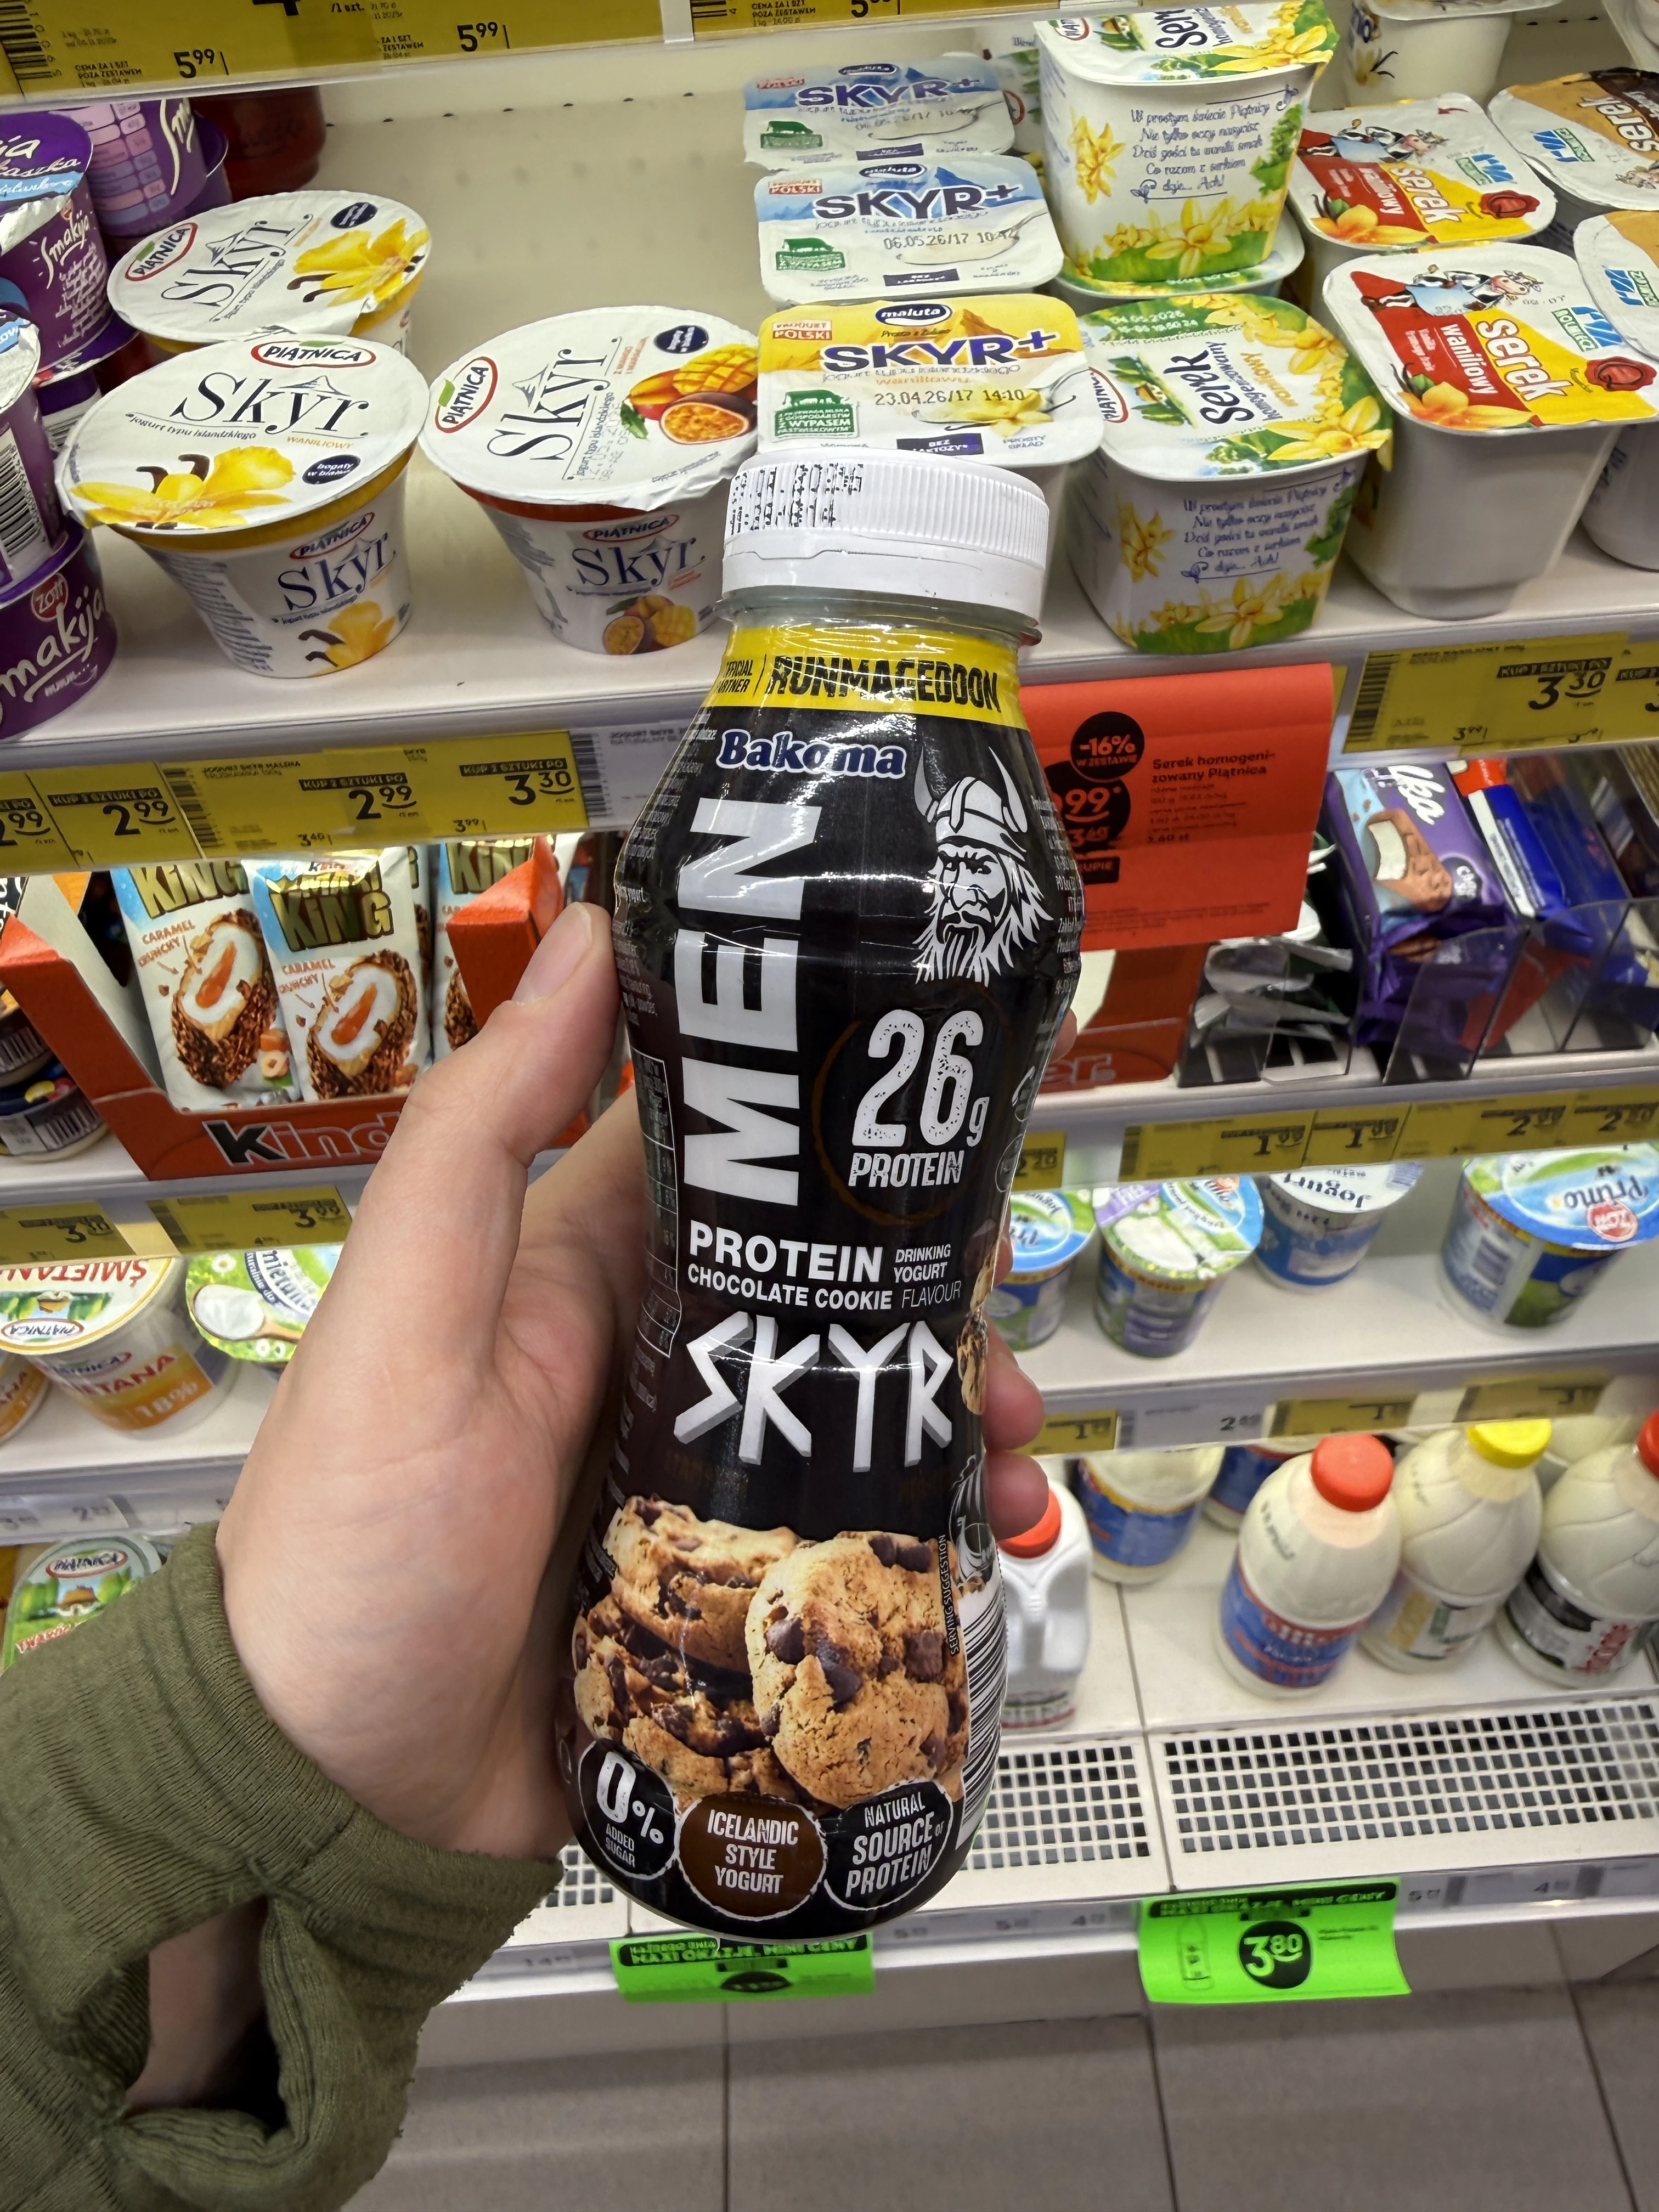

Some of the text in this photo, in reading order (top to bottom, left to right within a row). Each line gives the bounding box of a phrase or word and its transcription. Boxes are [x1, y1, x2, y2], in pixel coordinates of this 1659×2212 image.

[815, 184, 1022, 219] SKYR+
[1390, 166, 1469, 224] serek
[161, 221, 296, 308] Skyr
[773, 330, 831, 341] POLSKI
[881, 307, 940, 319] maluta
[822, 330, 1057, 373] SKYR+
[1440, 324, 1498, 394] waniliowy
[1476, 318, 1575, 402] serek
[169, 371, 370, 435] Skyr
[445, 363, 490, 425] PIĄTNICA
[486, 347, 611, 462] Skyr
[874, 390, 974, 406] 23.04.26/17
[1163, 349, 1255, 424] Serek
[793, 417, 851, 428] WYPASEM
[928, 439, 950, 447] BEZ
[278, 532, 388, 611] Skyr
[572, 537, 697, 586] Skyr
[0, 585, 105, 698] makija
[767, 655, 1002, 713] RUNMAGEDDON
[716, 729, 907, 780] Bakoma
[1079, 734, 1136, 756] -16%
[1152, 769, 1205, 784] zowany
[141, 919, 196, 945] CARAMEL
[269, 885, 394, 952] KING
[673, 797, 822, 1207] MEN
[202, 1111, 402, 1167] Kind
[848, 1150, 966, 1188] PROTEIN
[1562, 1175, 1650, 1210] Primo
[690, 1220, 883, 1283] PROTEIN
[893, 1262, 948, 1283] YOGURT
[894, 1244, 951, 1263] DRINKING
[687, 1262, 962, 1311] CHOCOLATE COOKIE FLAVOUR
[673, 1310, 954, 1474] SKYR
[938, 1534, 959, 1656] SERVING SUGGESTION
[596, 1751, 665, 1846] 0%
[864, 1792, 926, 1826] NATURAL
[605, 1824, 635, 1850] ADDED
[605, 1836, 636, 1867] SUGAR
[707, 1809, 799, 1846] ICELANDIC
[852, 1813, 946, 1864] SOURCE OF
[714, 1867, 784, 1894] YOGURT
[725, 1844, 776, 1870] STYLE
[845, 1847, 932, 1897] PROTEIN
